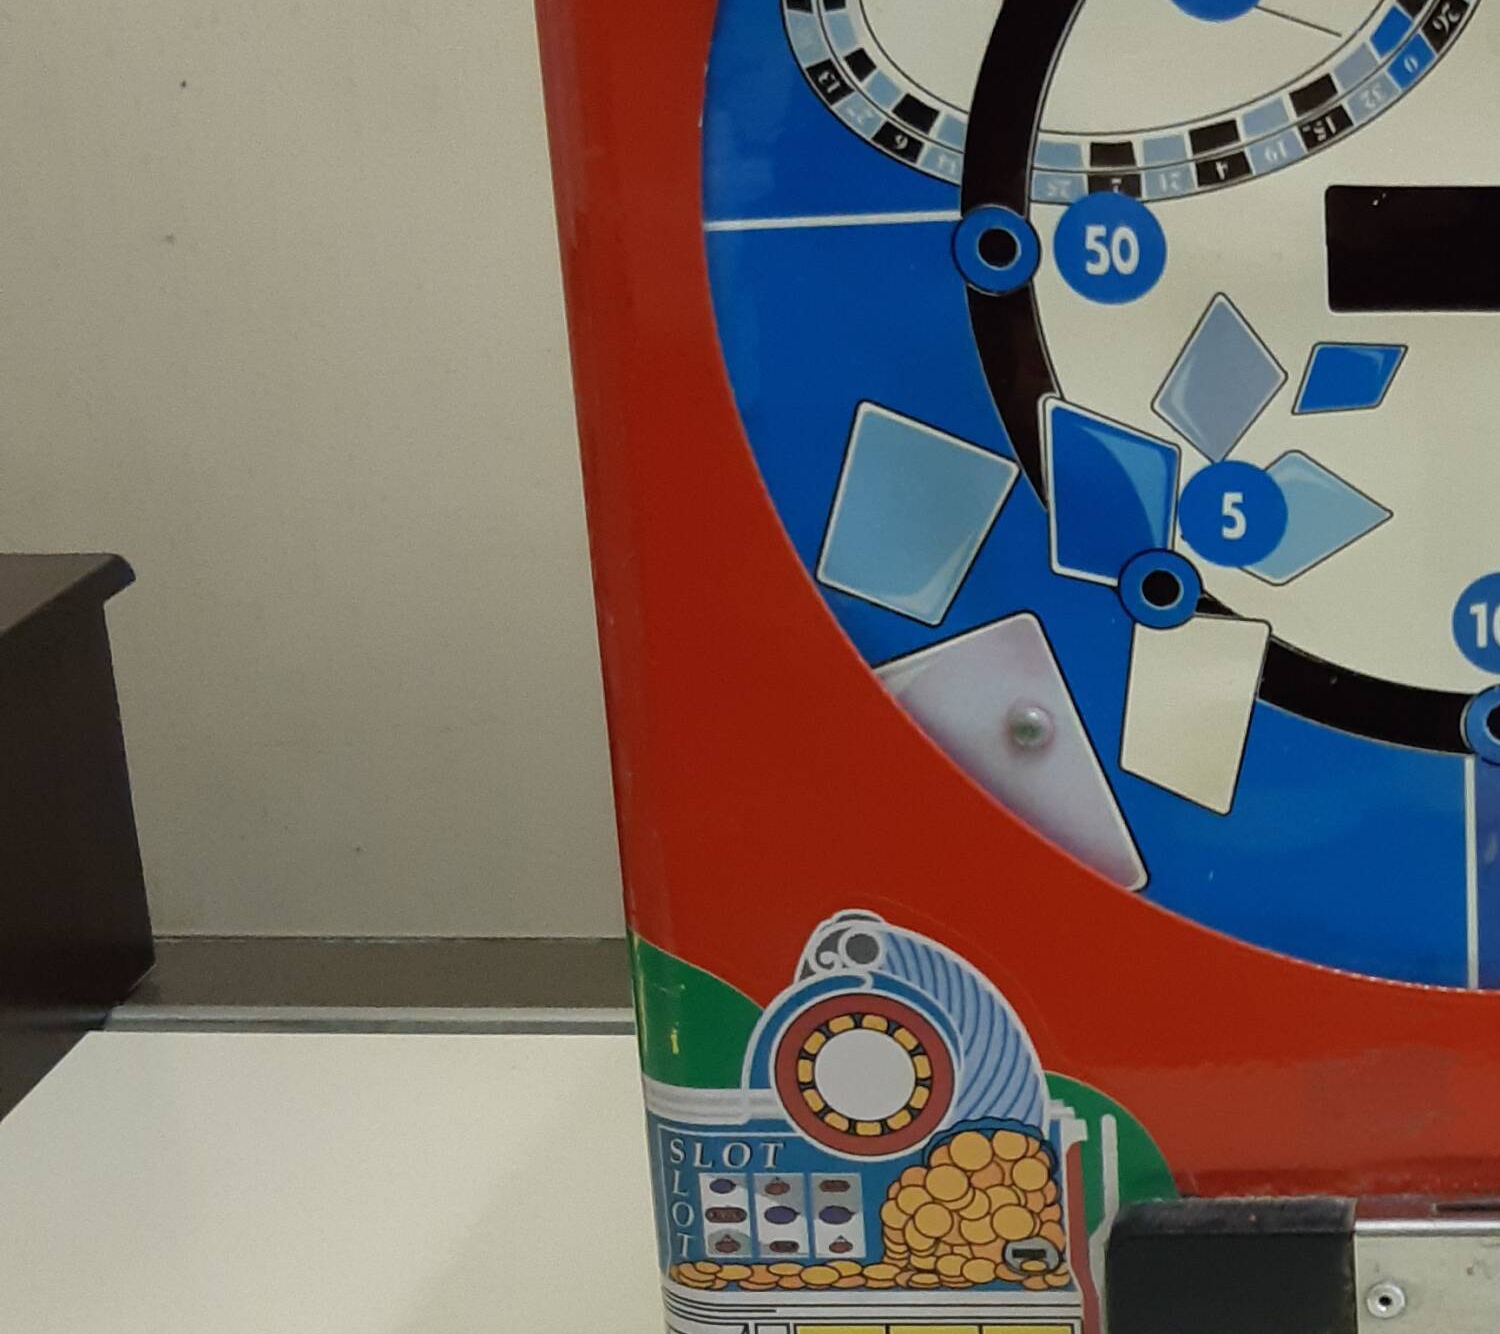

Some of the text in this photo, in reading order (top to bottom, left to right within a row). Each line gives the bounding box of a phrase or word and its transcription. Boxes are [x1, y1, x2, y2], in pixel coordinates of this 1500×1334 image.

[1432, 4, 1460, 34] 26
[1403, 55, 1419, 74] 0
[818, 70, 841, 93] 13
[1311, 116, 1337, 142] 15
[1264, 140, 1288, 165] 19
[1214, 160, 1229, 181] 4
[1084, 225, 1140, 275] 50
[1221, 493, 1246, 540] 5
[670, 1138, 785, 1169] SLOT
